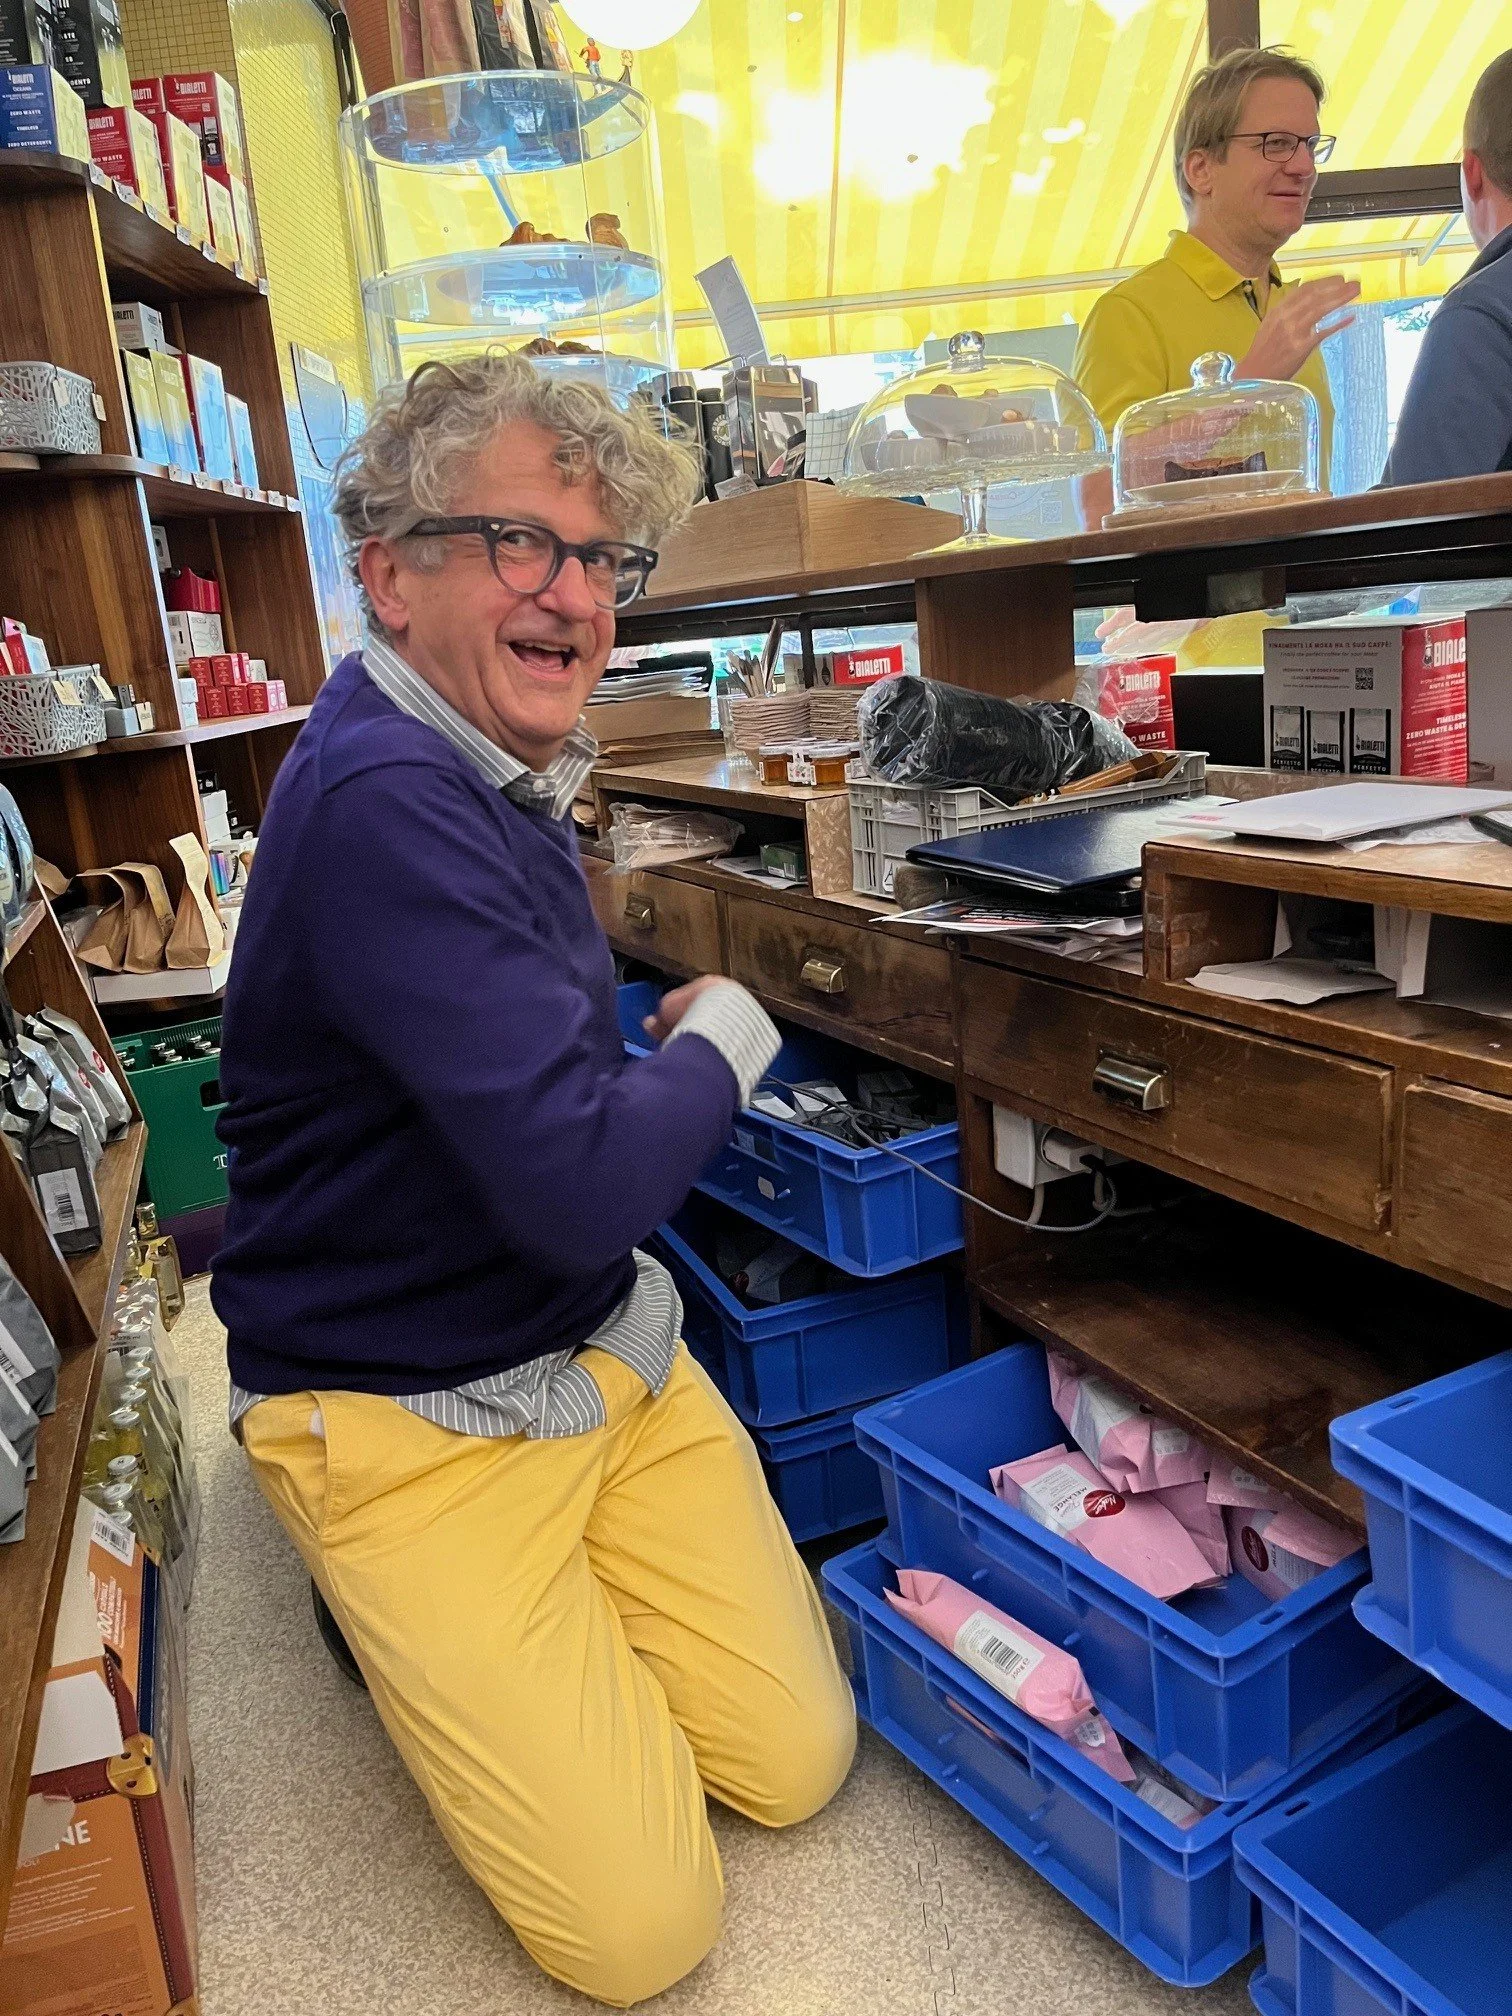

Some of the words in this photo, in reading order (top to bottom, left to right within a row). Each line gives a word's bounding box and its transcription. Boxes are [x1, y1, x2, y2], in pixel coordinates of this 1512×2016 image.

[132, 87, 152, 100] ALETTI
[180, 82, 207, 95] BIALETTI
[1434, 636, 1467, 668] BIALE
[855, 657, 891, 678] BIALETTI
[1125, 670, 1160, 692] BIALETTI
[1436, 712, 1467, 725] TIMELESS
[1138, 731, 1166, 742] WASTE
[1406, 731, 1424, 740] ZERO
[1424, 724, 1448, 736] WASTE
[1454, 721, 1467, 731] DET
[1353, 764, 1387, 772] PERFETTO
[1053, 1486, 1088, 1513] MELANGE
